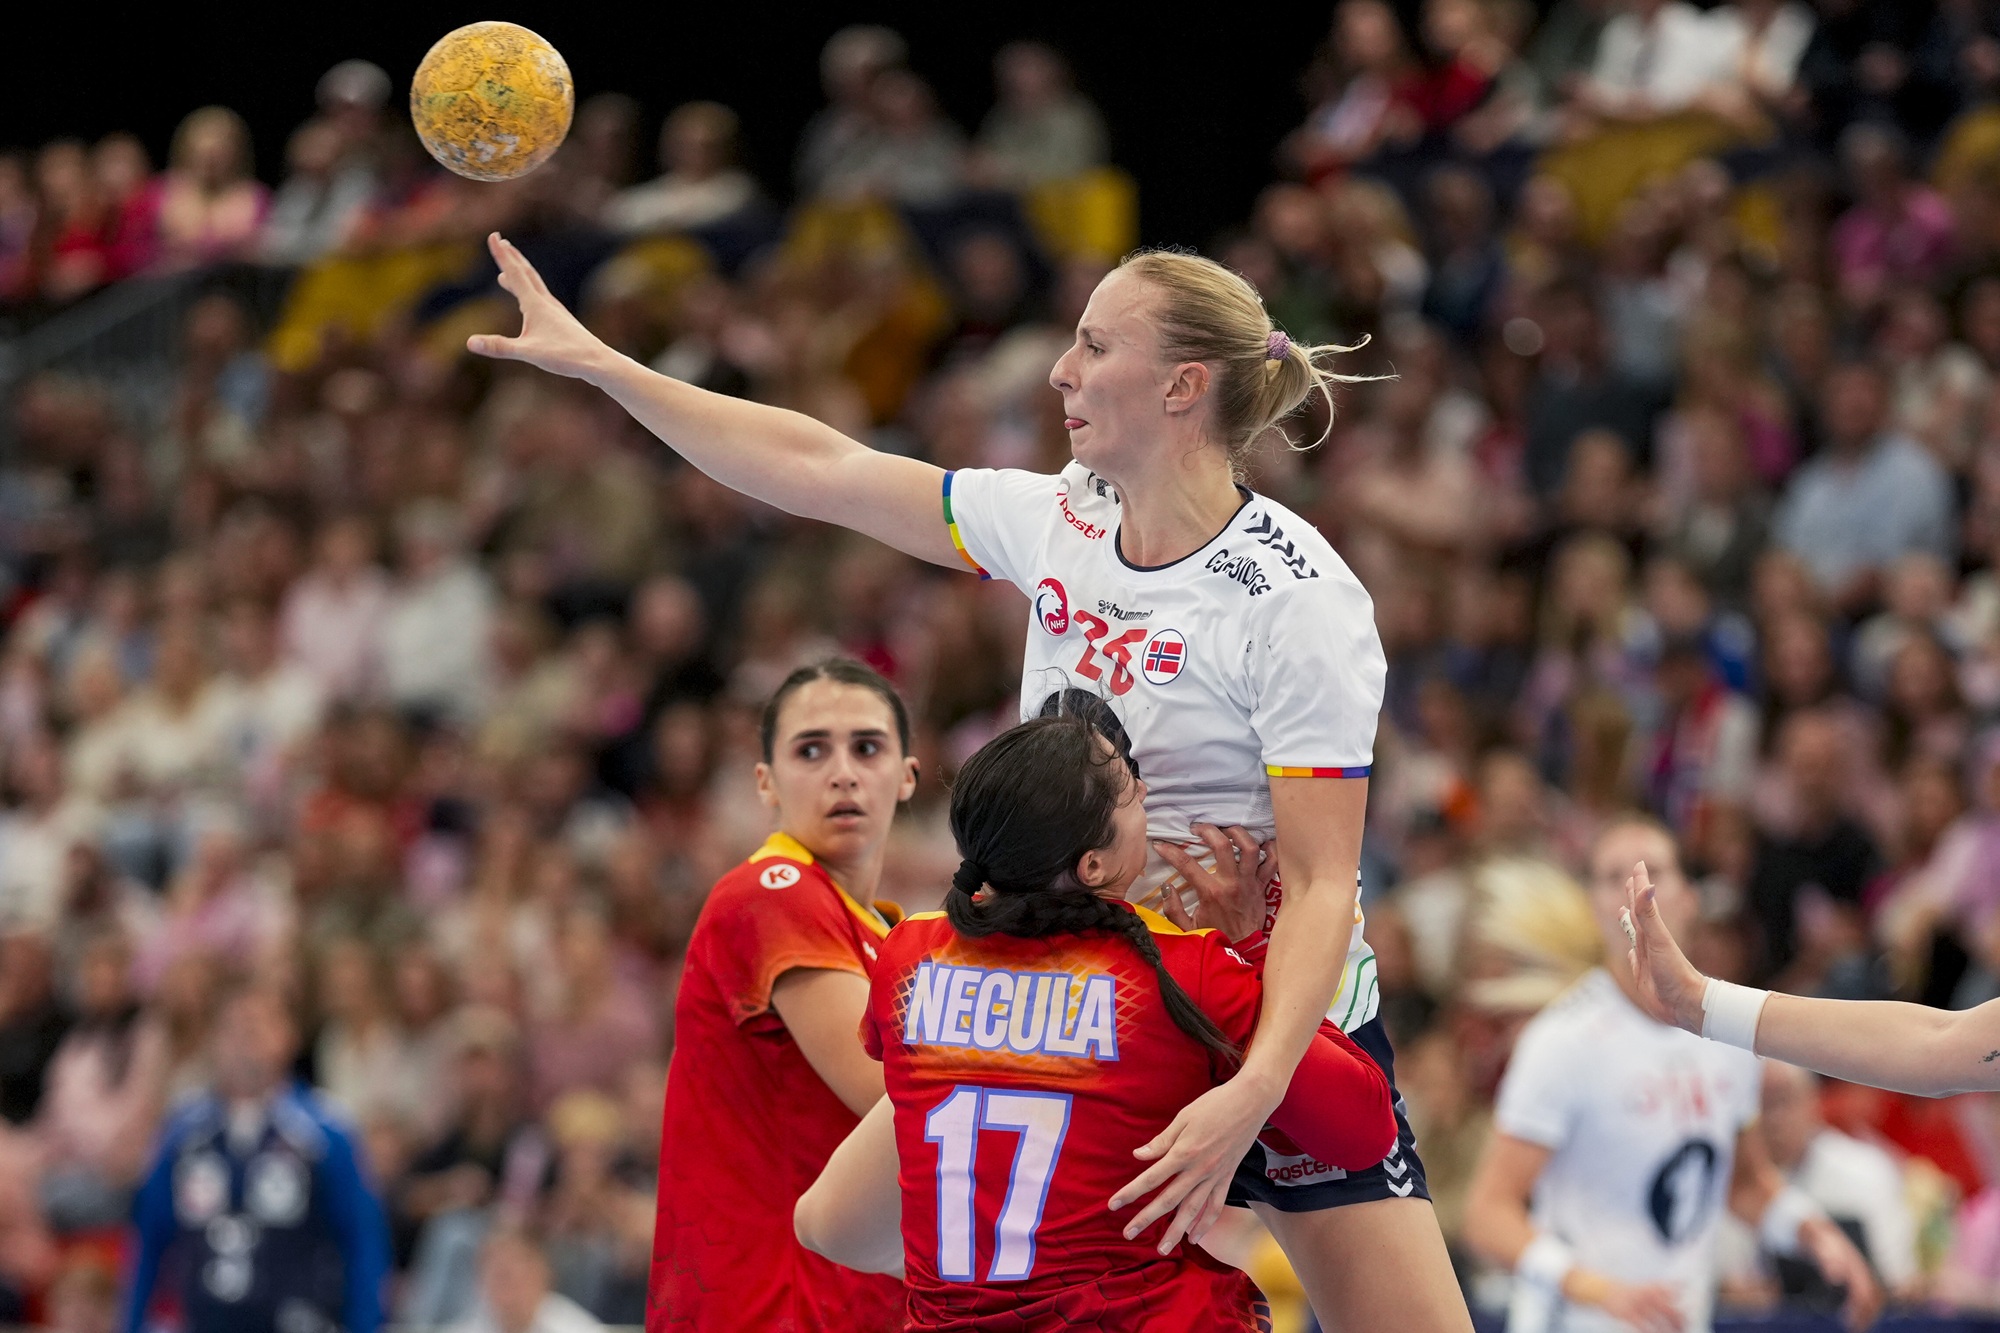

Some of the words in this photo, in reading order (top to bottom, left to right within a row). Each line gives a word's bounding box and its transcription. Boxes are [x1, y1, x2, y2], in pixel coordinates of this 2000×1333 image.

[1059, 497, 1106, 540] post
[1049, 619, 1066, 631] NHF
[1073, 609, 1148, 696] 26
[903, 962, 1120, 1061] NECULA
[924, 1085, 1074, 1282] 17
